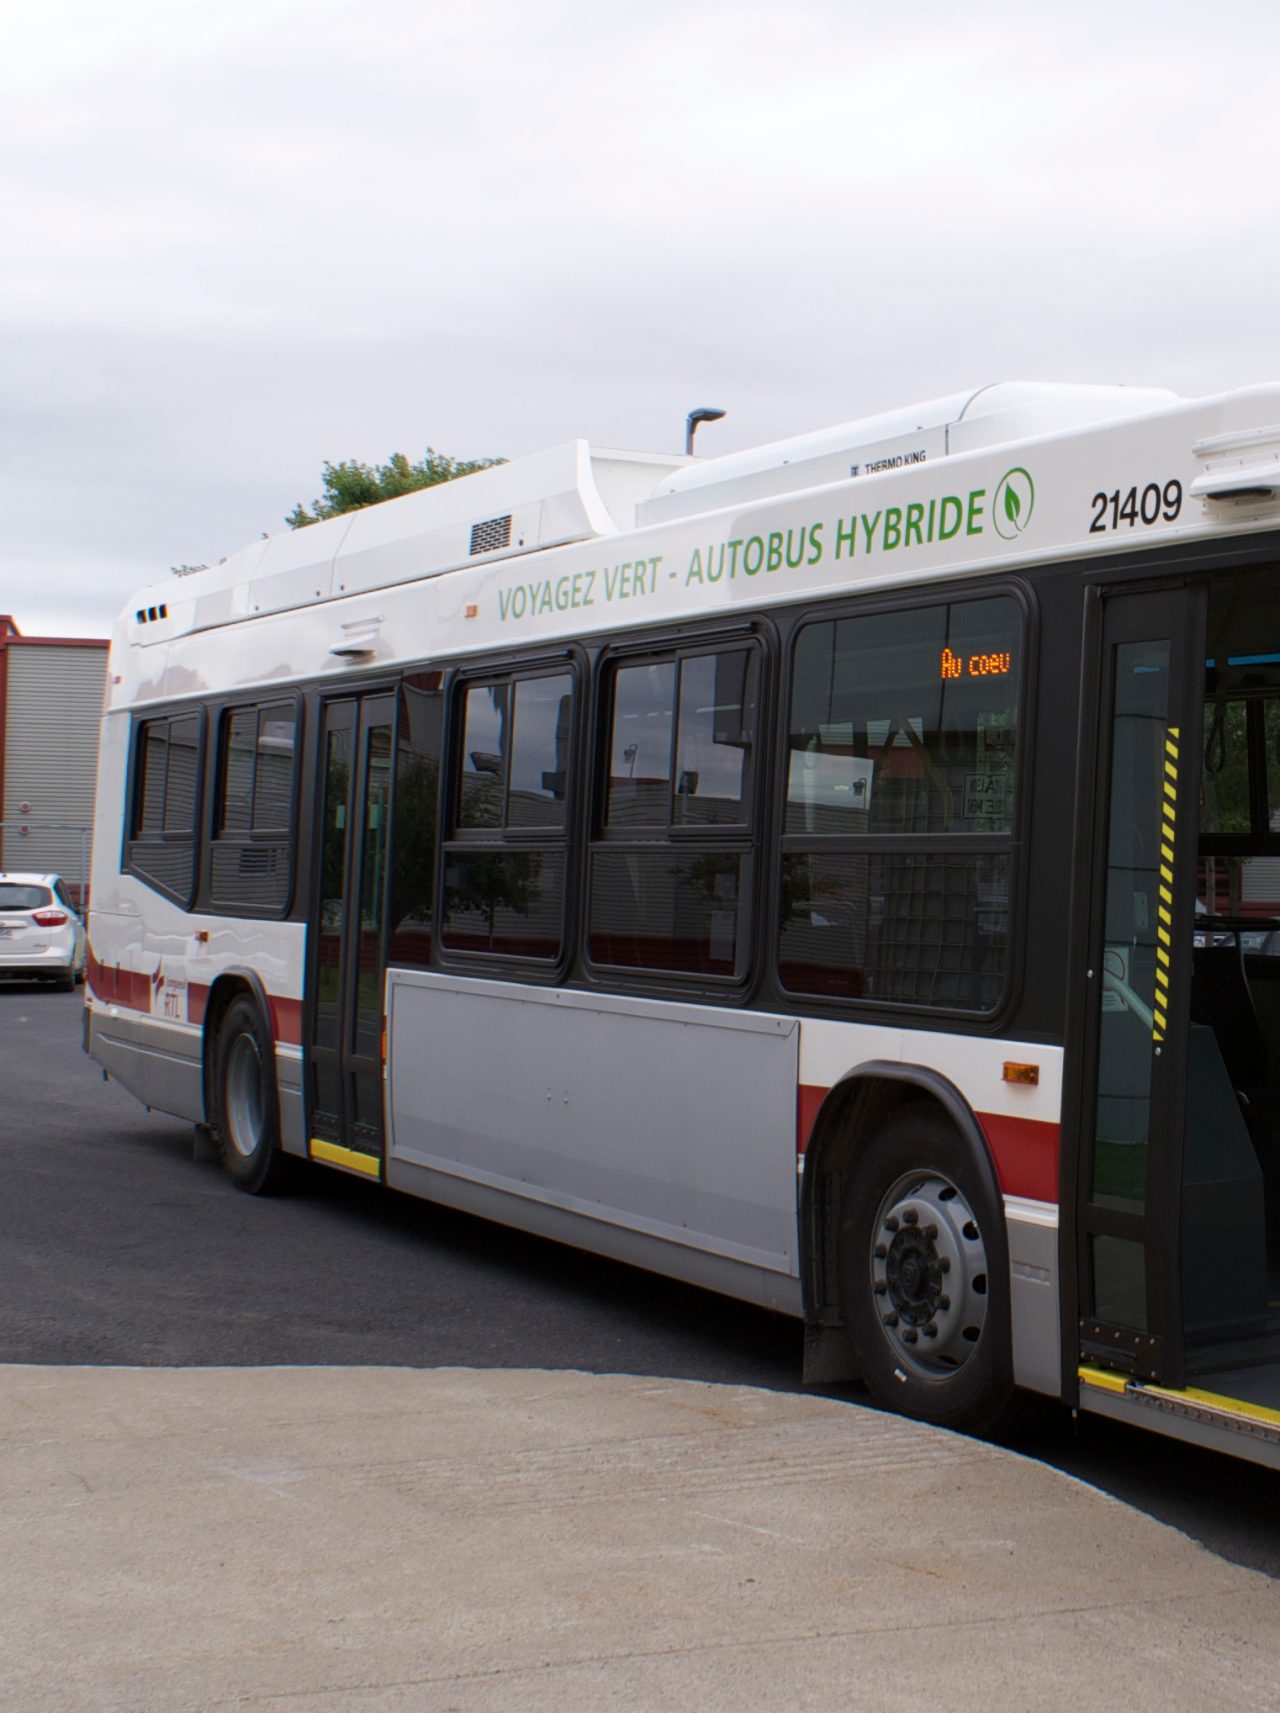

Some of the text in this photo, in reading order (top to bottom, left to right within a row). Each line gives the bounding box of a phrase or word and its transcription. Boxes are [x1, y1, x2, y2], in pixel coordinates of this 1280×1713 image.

[865, 456, 903, 474] THERMO
[904, 450, 926, 465] KING
[1089, 479, 1183, 533] 21409
[498, 571, 597, 622] VOYAGEZ
[604, 556, 663, 602] VERT
[685, 523, 824, 587] AUTOBUS
[835, 489, 987, 560] HYBRIDE
[941, 647, 962, 679] Au
